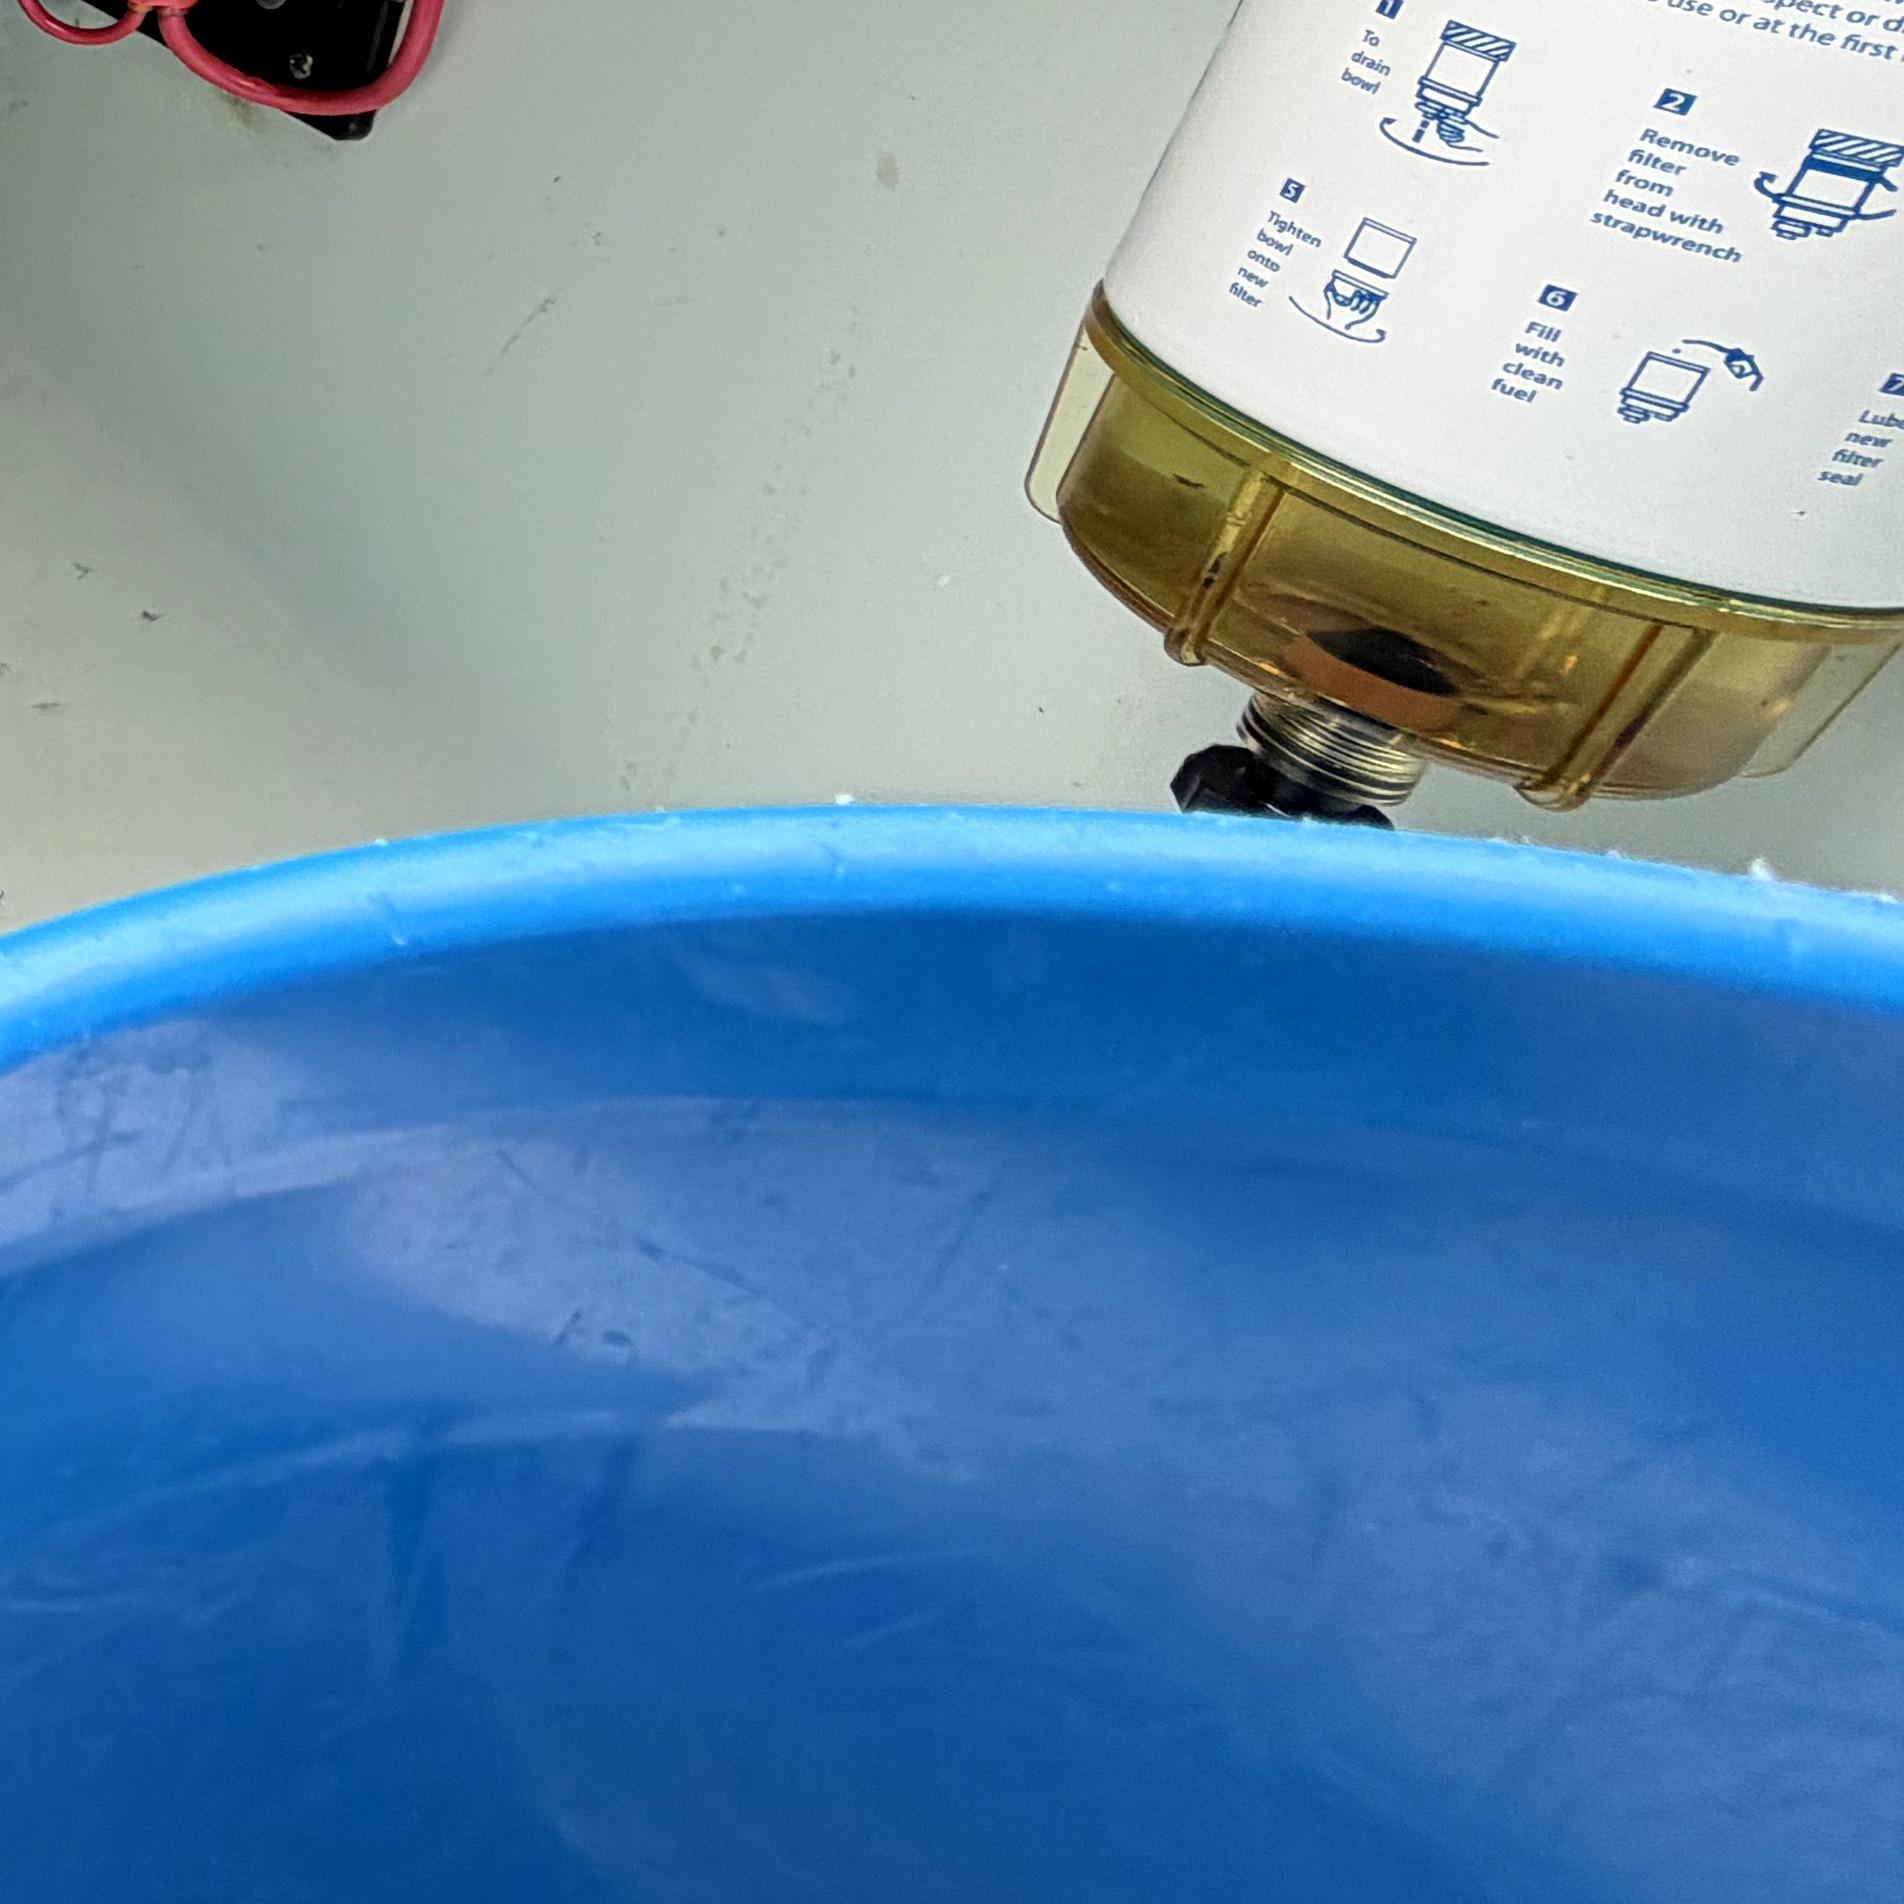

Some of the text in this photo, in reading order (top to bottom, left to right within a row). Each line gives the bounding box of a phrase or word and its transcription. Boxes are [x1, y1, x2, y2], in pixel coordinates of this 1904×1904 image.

[1846, 10, 1880, 26] or
[1362, 29, 1380, 47] To
[1719, 9, 1752, 25] or
[1753, 17, 1785, 34] at
[1788, 23, 1836, 46] the
[1840, 34, 1898, 60] first
[1351, 51, 1391, 76] drain
[1341, 67, 1381, 95] bowl
[1639, 128, 1740, 166] Remove
[1627, 149, 1687, 175] filter
[1615, 169, 1674, 197] from
[1603, 189, 1724, 234] head with
[1268, 210, 1322, 248] Tighten
[1590, 211, 1742, 263] strapwrench
[1256, 228, 1294, 256] bowl
[1247, 250, 1280, 272] onto
[1237, 267, 1269, 288] new
[1229, 282, 1263, 307] filter
[1525, 321, 1562, 343] Fill
[1515, 343, 1565, 367] with
[1502, 362, 1563, 390] clean
[1491, 378, 1537, 403] fuel
[1844, 432, 1893, 448] new
[1832, 449, 1884, 468] filter
[1817, 471, 1864, 486] seal
